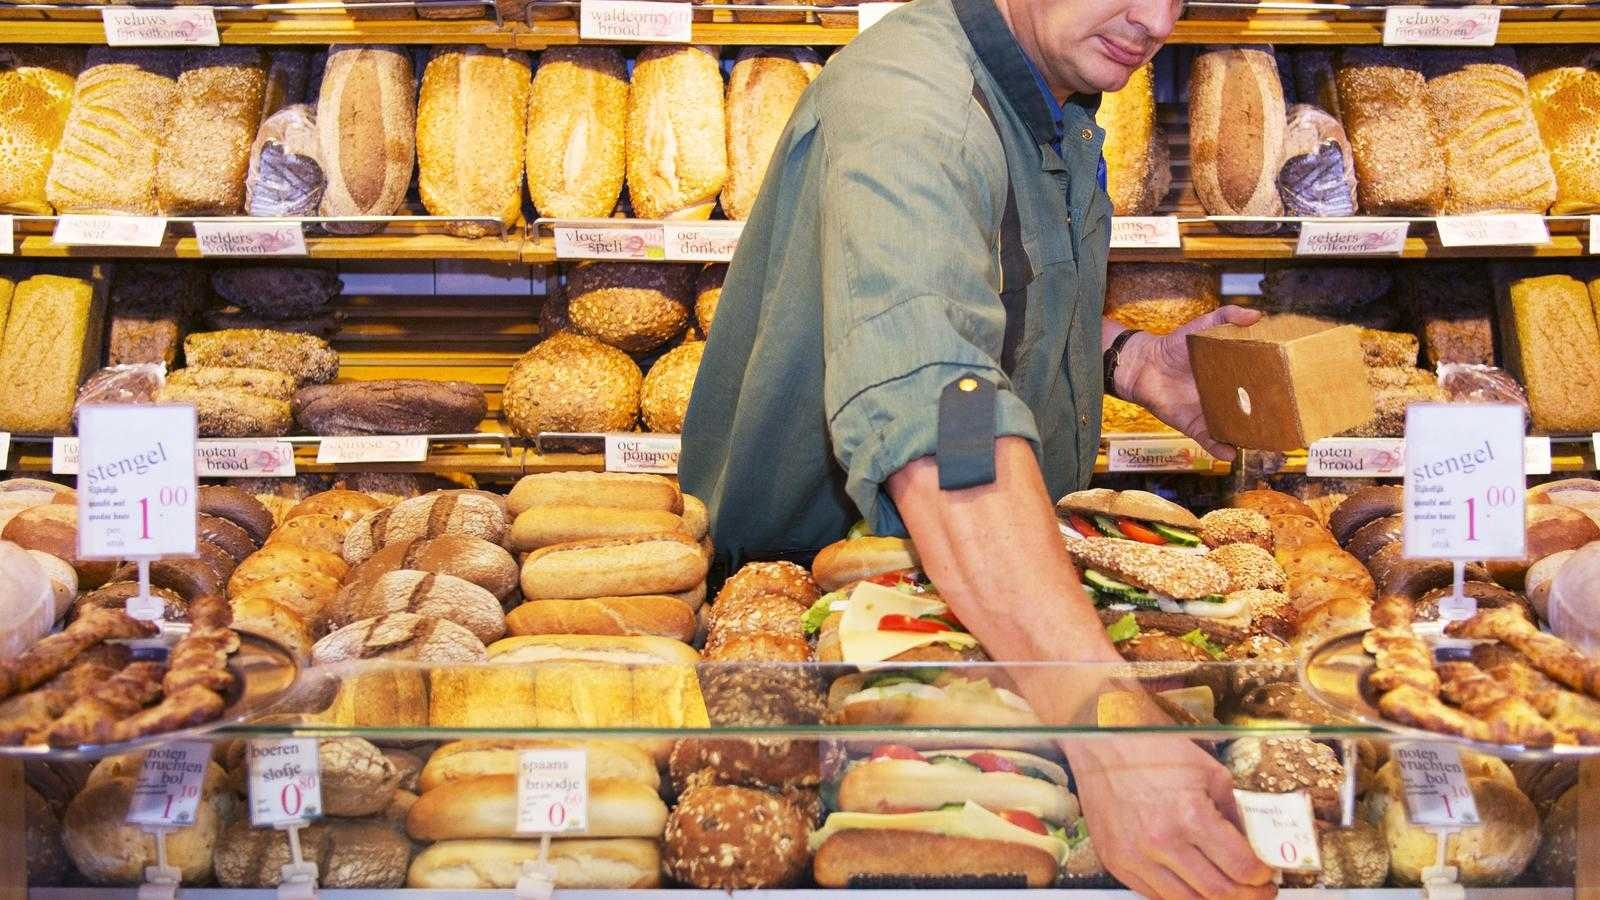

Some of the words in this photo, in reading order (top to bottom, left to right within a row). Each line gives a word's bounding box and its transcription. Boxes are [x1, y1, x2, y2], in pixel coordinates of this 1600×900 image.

[114, 13, 167, 26] veluws
[1397, 12, 1450, 25] veluws
[599, 22, 640, 36] brood
[201, 232, 253, 245] gelders
[565, 230, 604, 242] vloer
[677, 231, 699, 241] oer
[1308, 231, 1359, 245] gelders
[588, 240, 623, 253] spelt
[197, 447, 237, 457] noten
[617, 441, 641, 452] oer
[1117, 448, 1143, 457] oer
[1310, 446, 1352, 458] noten
[87, 442, 168, 485] stengel
[623, 450, 680, 465] pompoe
[1413, 440, 1495, 484] stengel
[207, 458, 249, 471] brood
[1319, 458, 1363, 471] brood
[137, 496, 152, 540] 1
[159, 486, 188, 508] 00
[1464, 496, 1480, 542] 1
[1486, 486, 1516, 507] 00
[148, 748, 187, 761] noten
[252, 743, 300, 758] boeren
[1398, 747, 1439, 760] noten
[144, 759, 203, 773] vruchten
[522, 760, 569, 773] spaans
[1399, 759, 1461, 773] vruchten
[161, 772, 184, 785] bol
[262, 763, 302, 783] slofje
[1424, 772, 1449, 785] bol
[526, 777, 580, 792] broodje
[161, 794, 175, 819] 1
[280, 783, 302, 817] 0
[1440, 793, 1455, 819] 1
[548, 801, 566, 827] 0
[1280, 841, 1297, 863] 0
